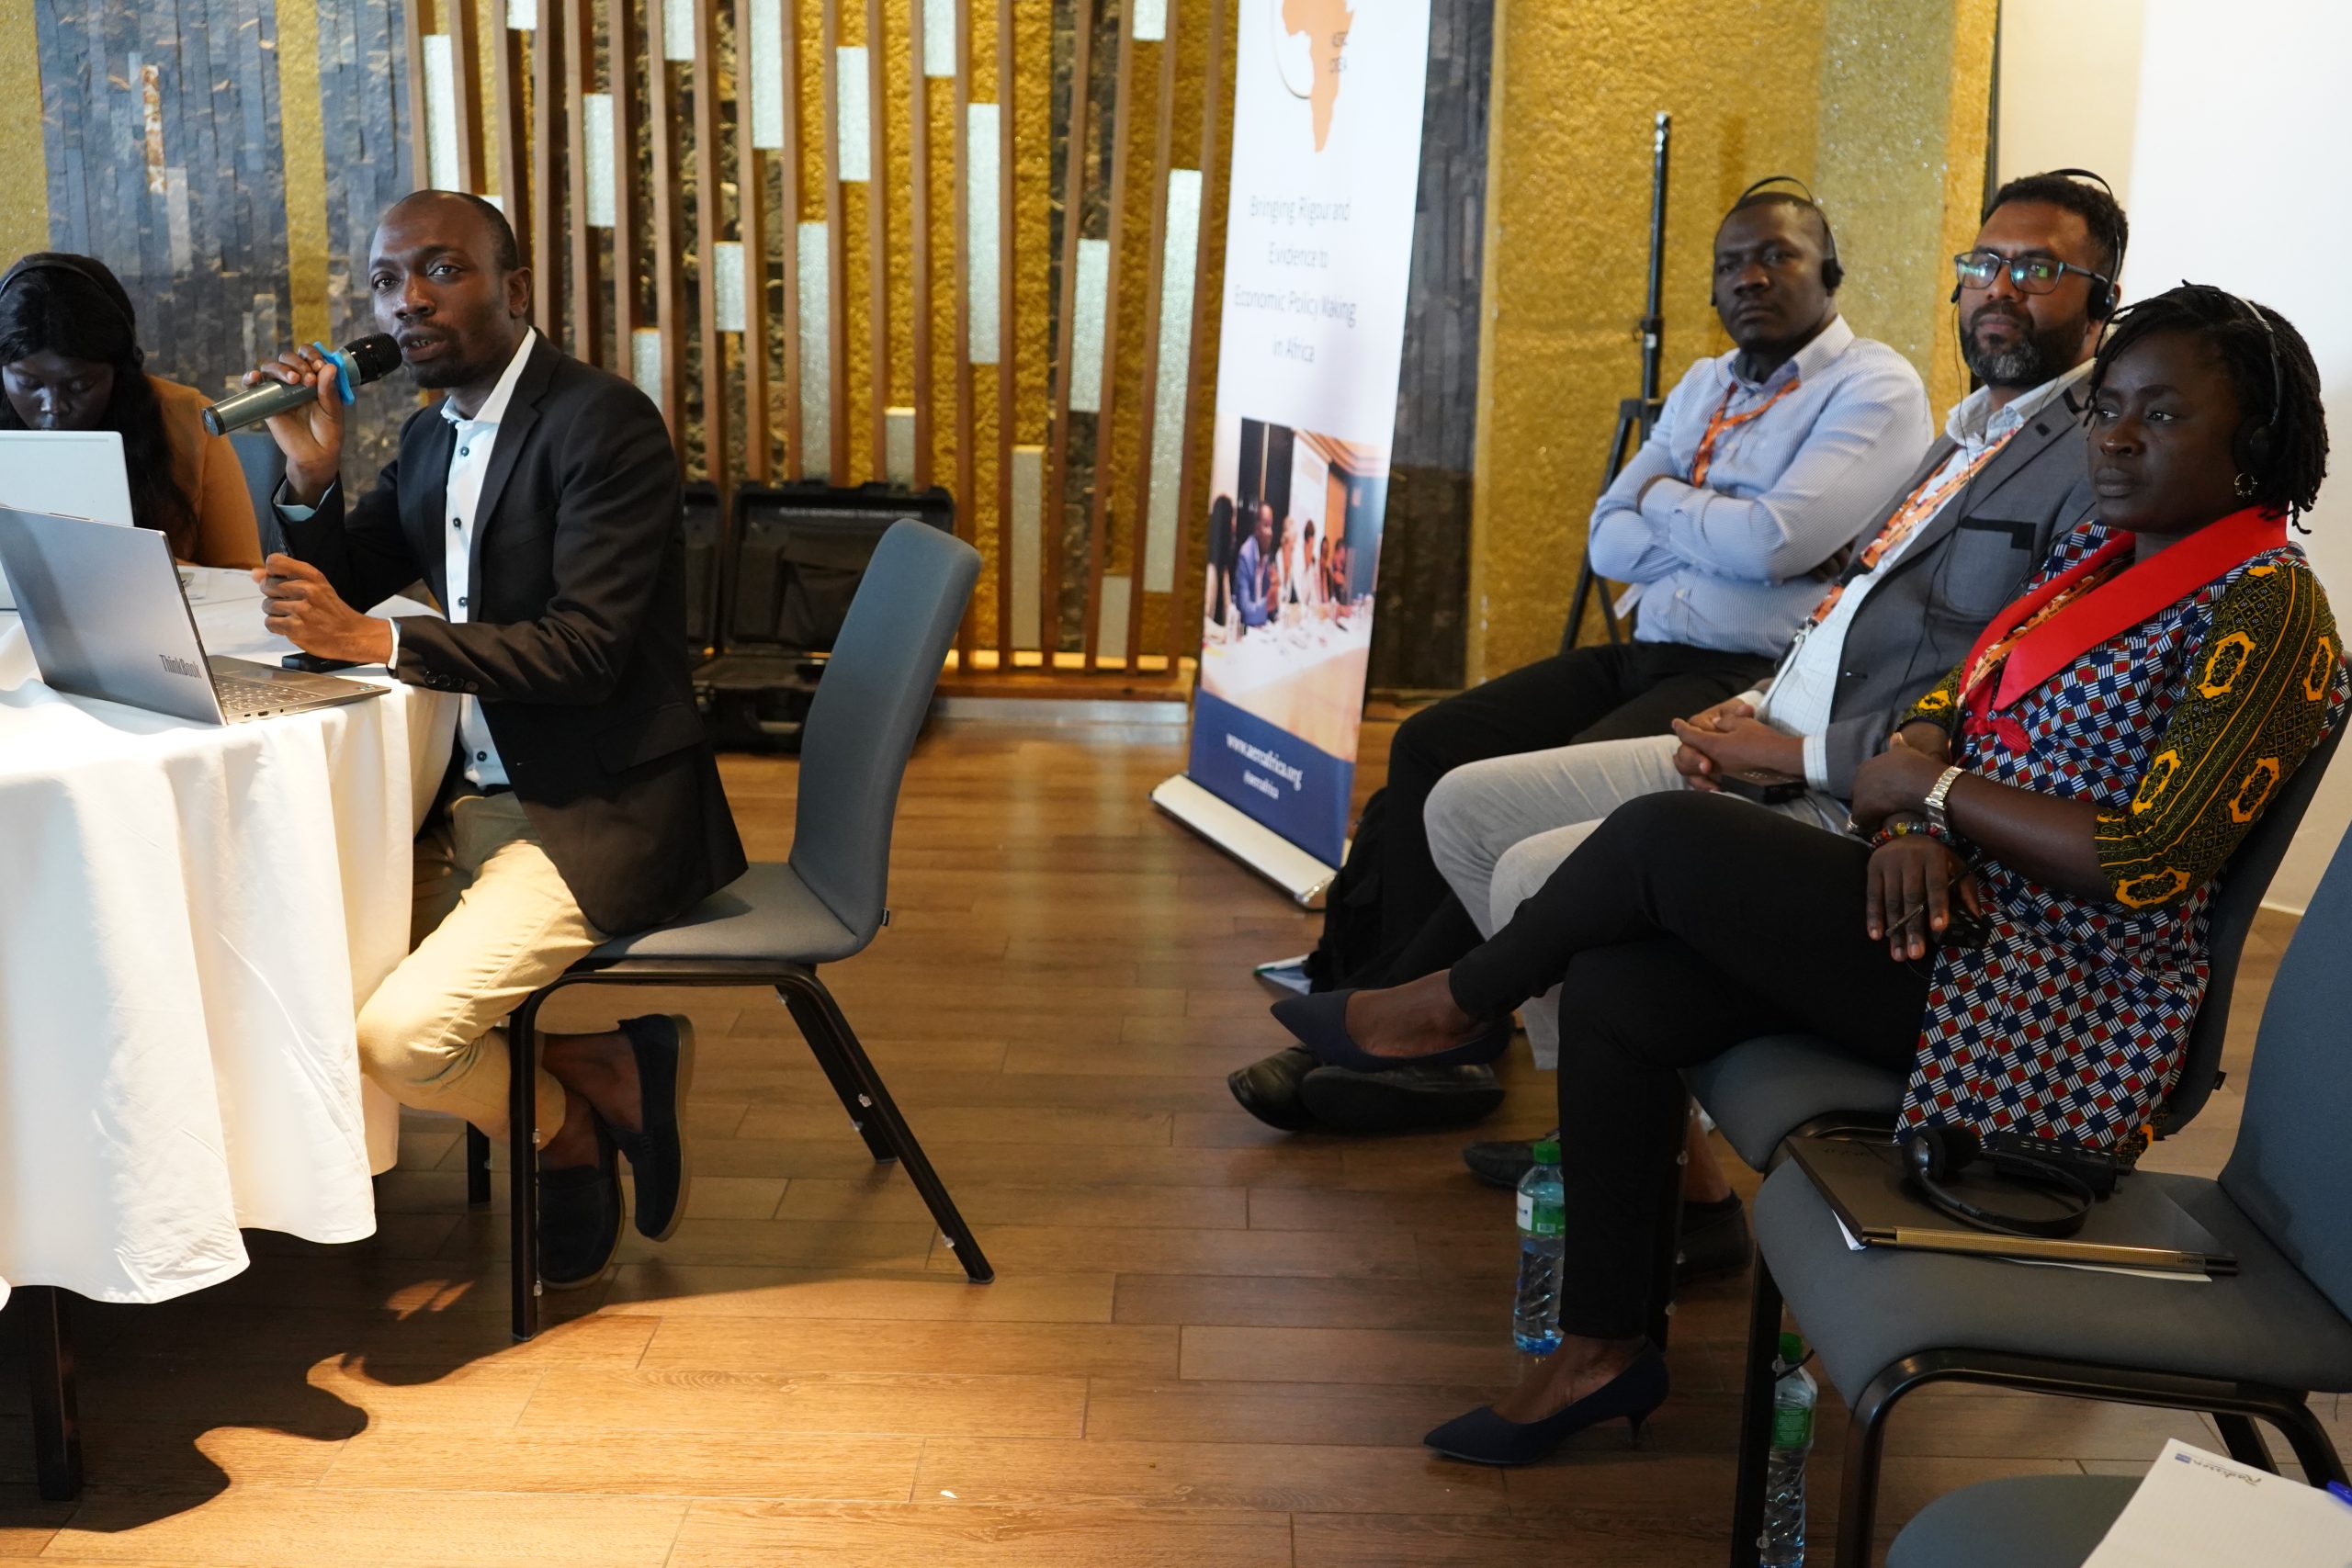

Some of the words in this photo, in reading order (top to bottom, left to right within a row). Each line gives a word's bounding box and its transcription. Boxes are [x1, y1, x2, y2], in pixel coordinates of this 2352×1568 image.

[1250, 195, 1295, 225] Bringing
[1333, 197, 1351, 221] and
[1268, 242, 1317, 267] Evidence
[1319, 249, 1329, 268] to
[1235, 285, 1286, 311] Economic
[1288, 290, 1317, 321] Policy
[1272, 334, 1283, 356] in
[1286, 337, 1316, 363] Africa
[159, 654, 202, 679] ThinkBook
